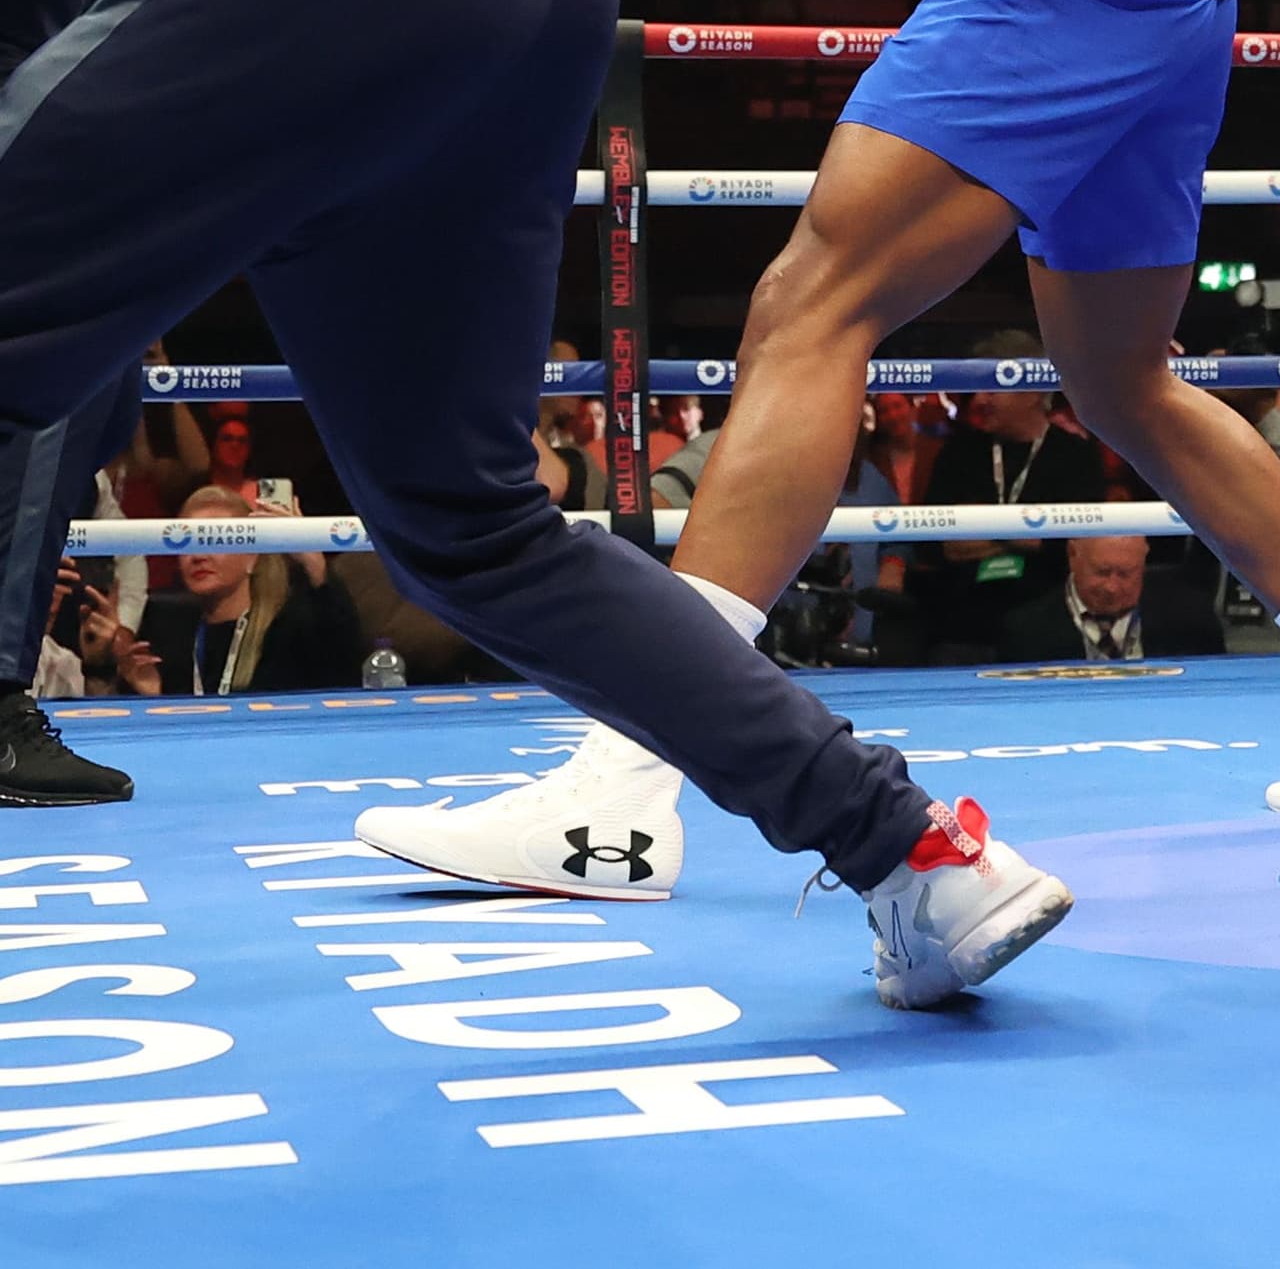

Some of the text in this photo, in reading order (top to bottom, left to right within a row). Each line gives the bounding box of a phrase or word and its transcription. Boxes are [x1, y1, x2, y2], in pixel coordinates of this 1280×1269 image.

[700, 29, 753, 40] RIYADH
[700, 41, 753, 51] SEASON
[848, 43, 880, 53] SEAS
[720, 179, 773, 189] RIYADH
[721, 190, 773, 199] SEASON
[611, 229, 630, 308] EDITION
[880, 363, 932, 373] RIYADH
[1169, 359, 1218, 370] RIYADH
[183, 367, 242, 377] RIYADH
[880, 374, 932, 383] SEASON
[1026, 372, 1061, 383] SEAS
[183, 378, 241, 389] SEASON
[614, 436, 636, 515] EDITION
[903, 518, 956, 529] SEASON
[1052, 513, 1103, 525] SEASON
[198, 524, 256, 534] RIYADH
[198, 536, 256, 546] SEASON
